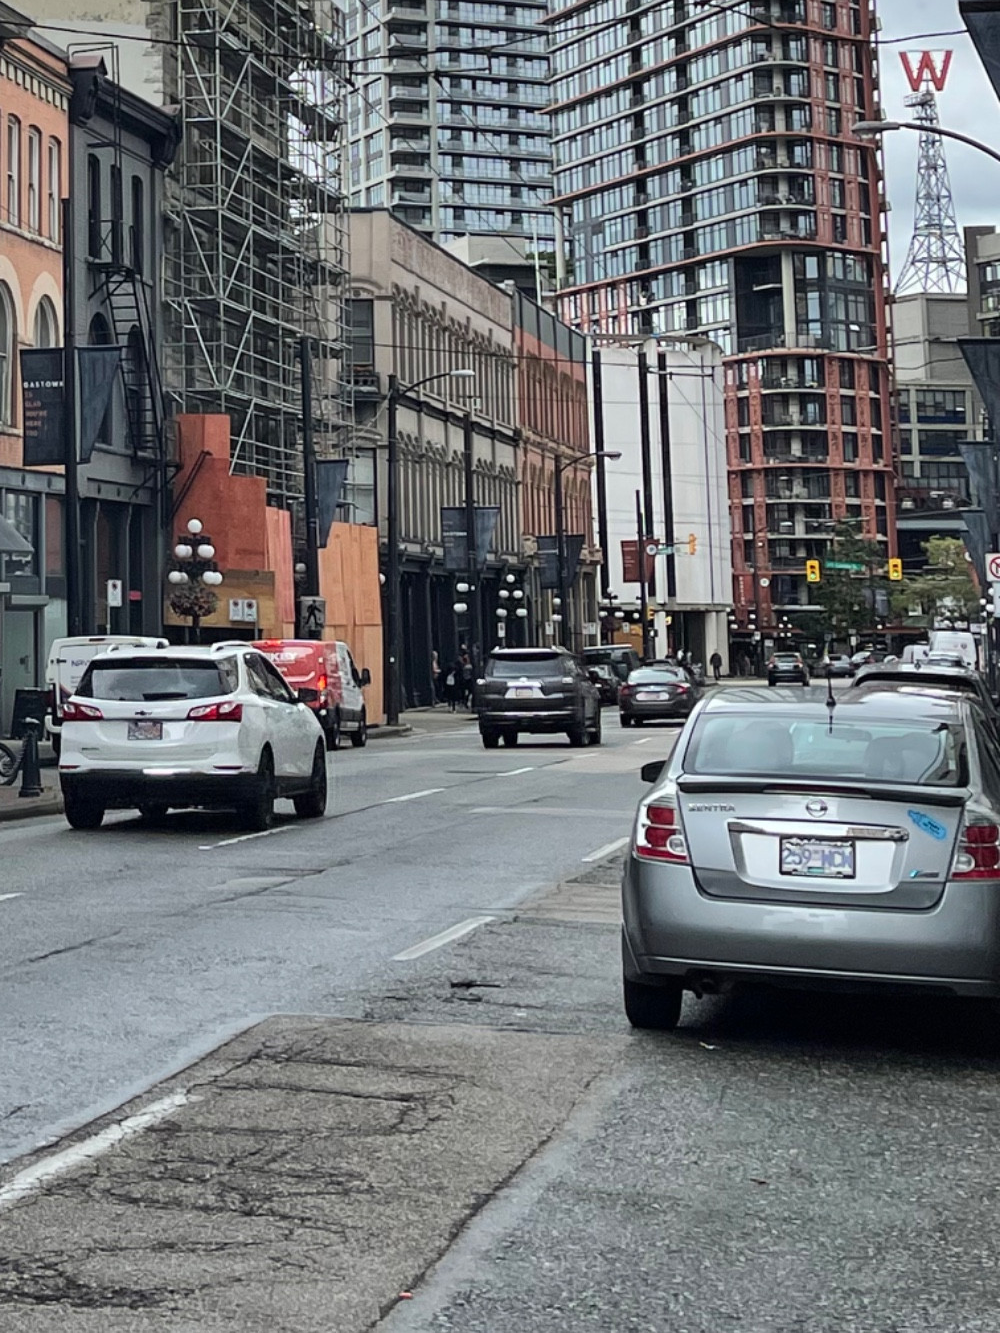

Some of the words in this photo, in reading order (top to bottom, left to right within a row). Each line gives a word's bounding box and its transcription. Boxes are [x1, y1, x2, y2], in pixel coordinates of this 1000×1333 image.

[898, 50, 953, 92] W
[23, 380, 64, 388] GASTOWN
[688, 803, 736, 812] SENTRA
